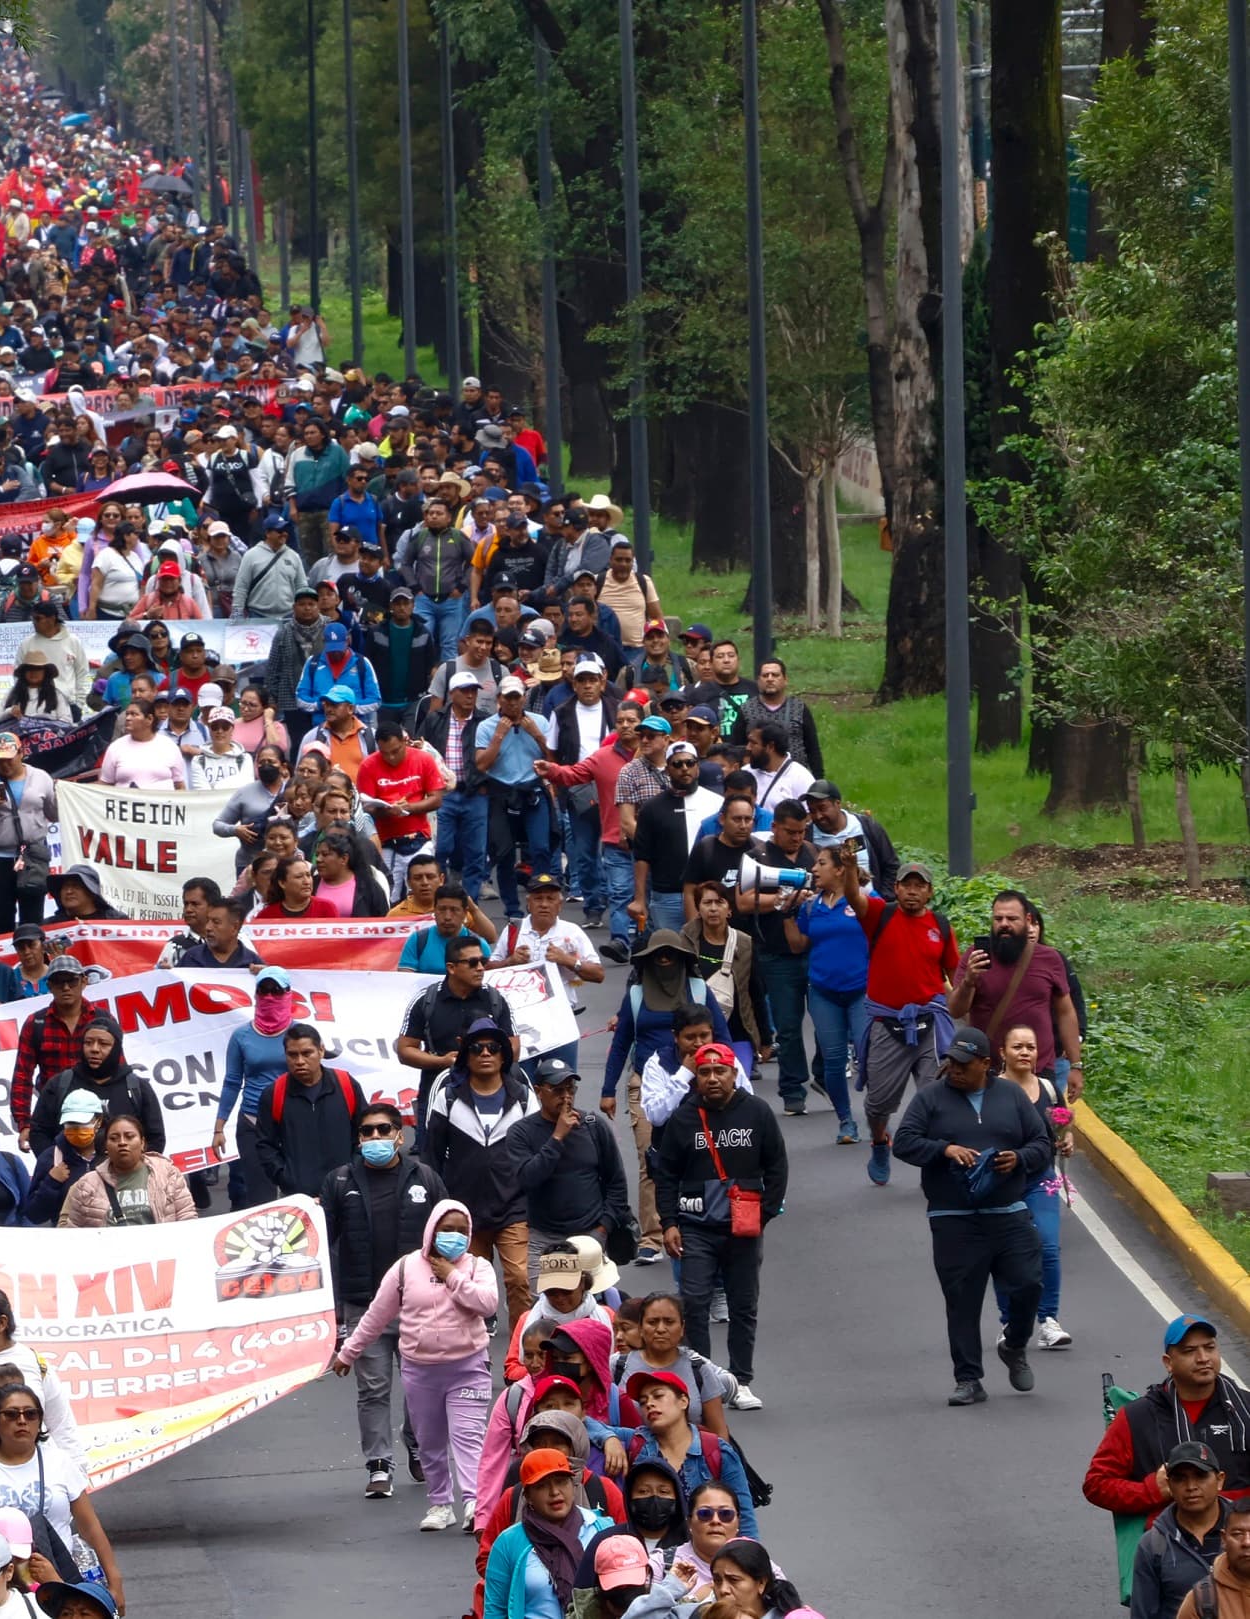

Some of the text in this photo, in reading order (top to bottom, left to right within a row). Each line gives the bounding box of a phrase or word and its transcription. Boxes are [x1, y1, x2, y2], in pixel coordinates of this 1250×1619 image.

[77, 825, 177, 873] VALLE
[541, 1258, 579, 1270] PORT
[72, 1258, 177, 1319] XIV
[14, 1316, 174, 1337] EMOCRÁTICA
[192, 1342, 220, 1359] 4
[231, 1319, 331, 1358] (403)
[64, 1358, 266, 1400] UERRERO.
